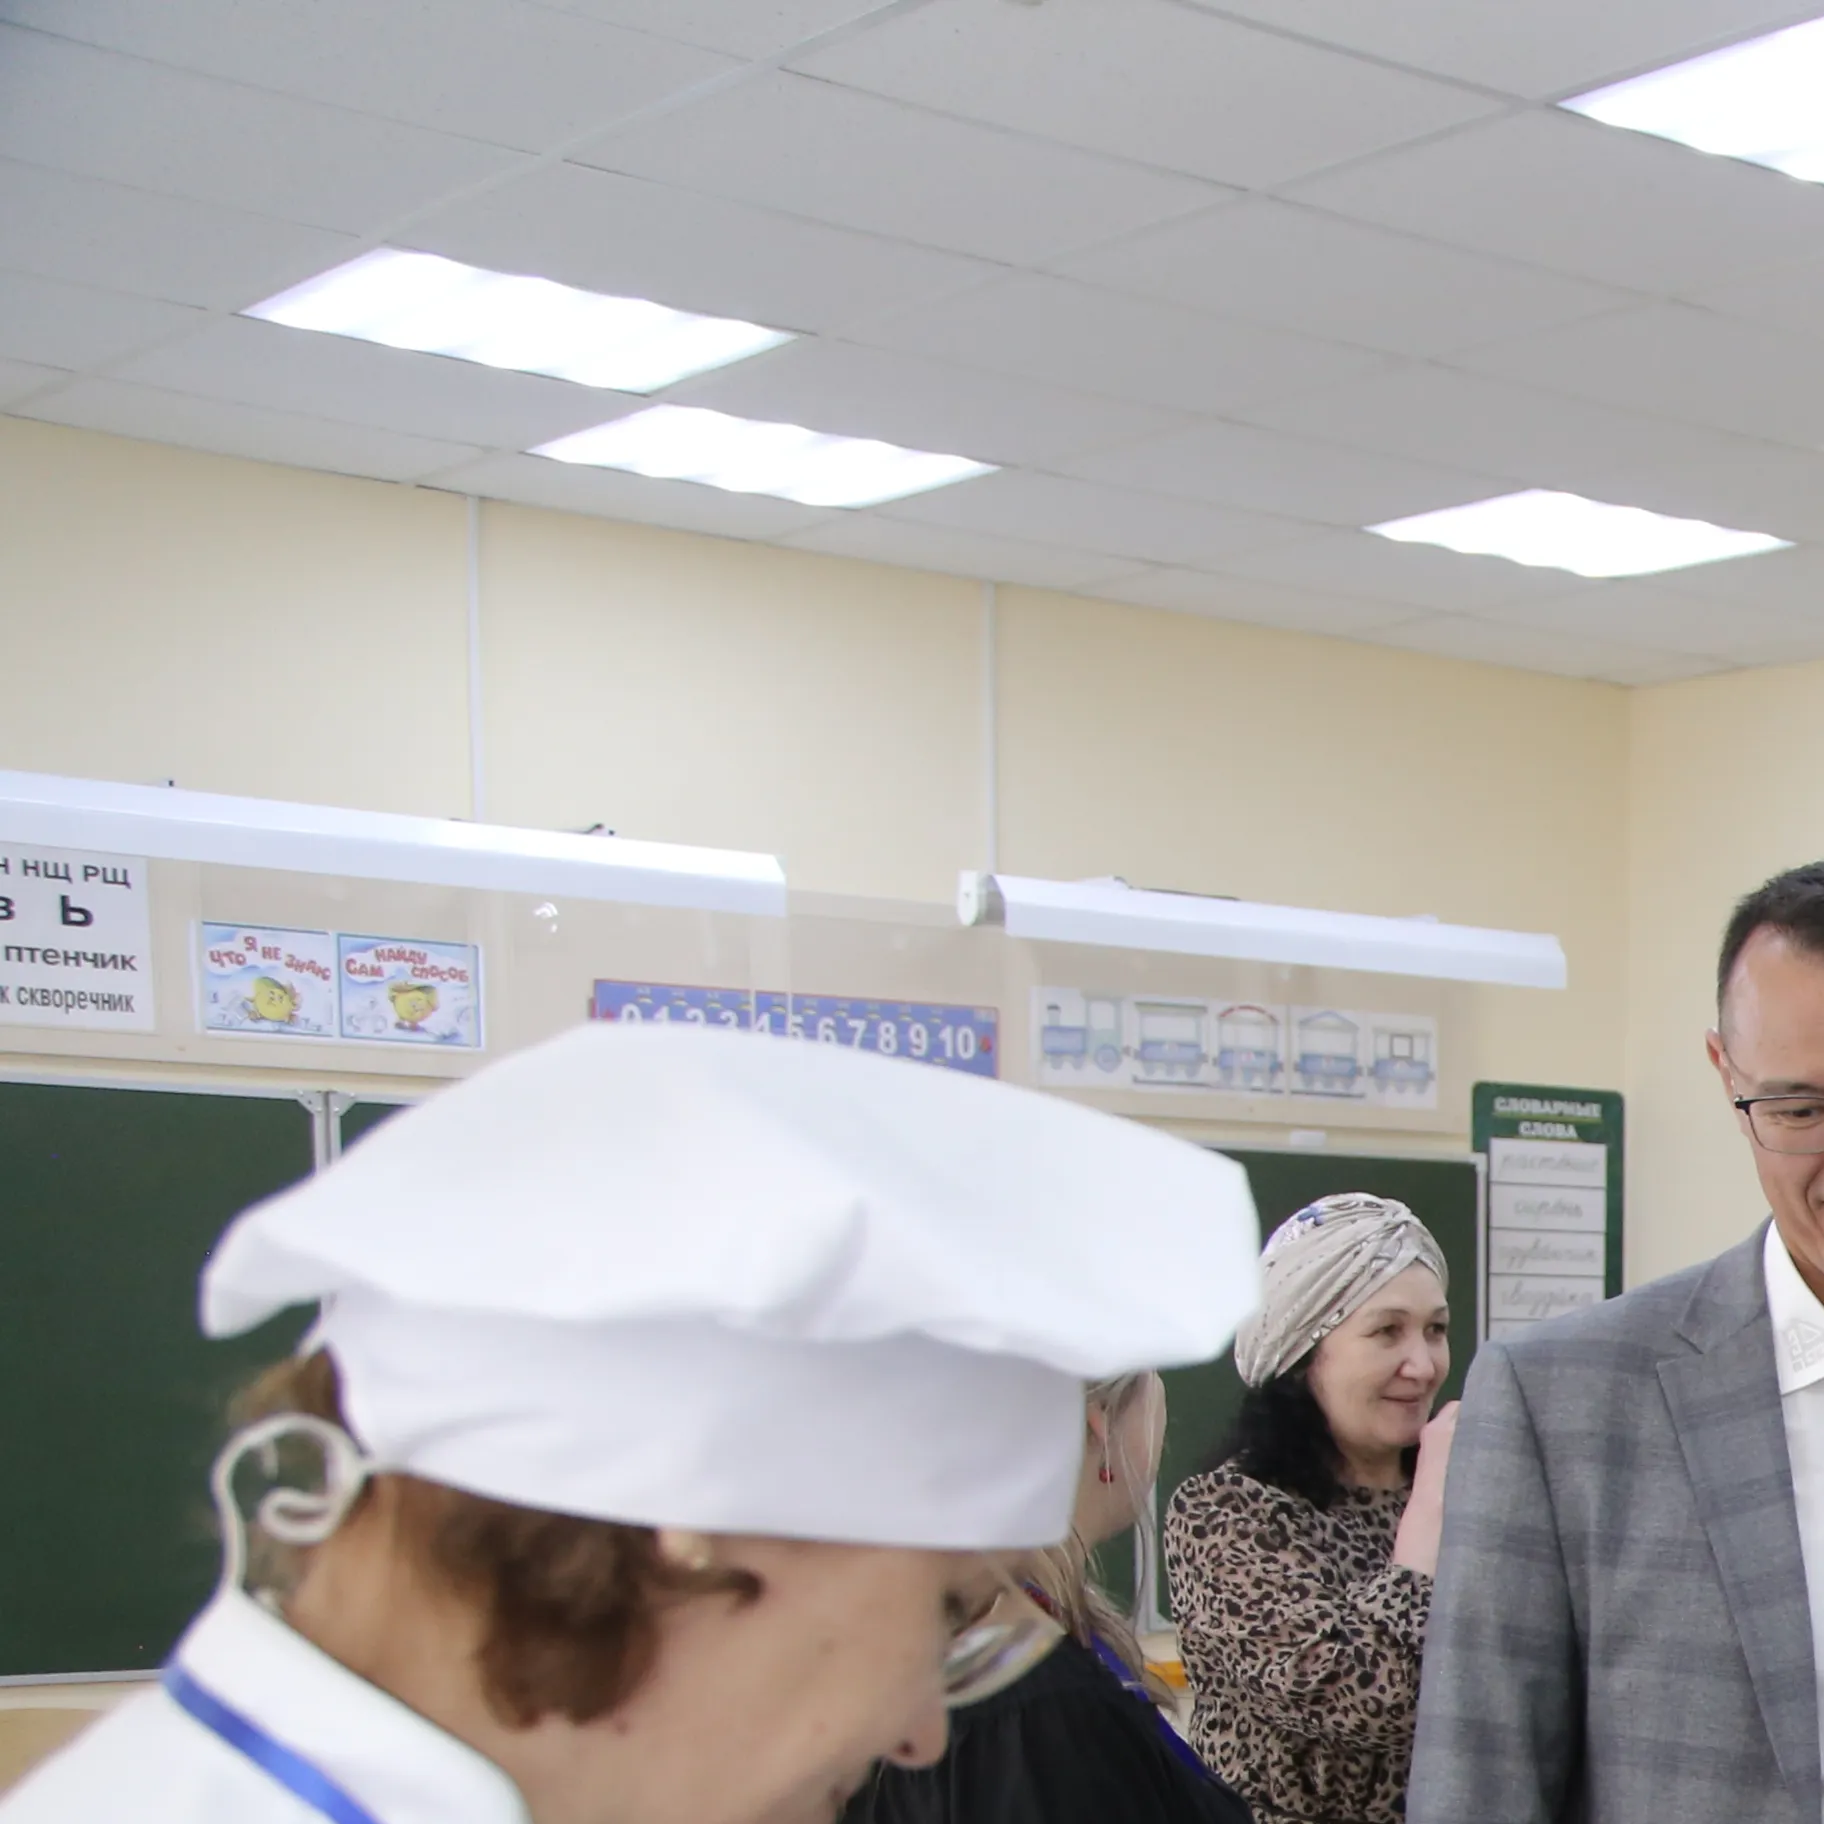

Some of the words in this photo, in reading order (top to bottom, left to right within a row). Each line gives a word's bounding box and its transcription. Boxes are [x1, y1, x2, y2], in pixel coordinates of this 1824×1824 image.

[5, 944, 138, 972] птенчик
[244, 936, 258, 952] Я
[262, 946, 281, 961] НЕ
[17, 985, 136, 1014] скворечник
[817, 1017, 838, 1043] 6
[847, 1019, 868, 1048] 7
[878, 1020, 898, 1054] 8
[908, 1023, 928, 1057] 9
[938, 1025, 976, 1060] 10
[1494, 1096, 1603, 1118] СЛОВАРНЫЕ
[1519, 1121, 1579, 1139] СЛОВА
